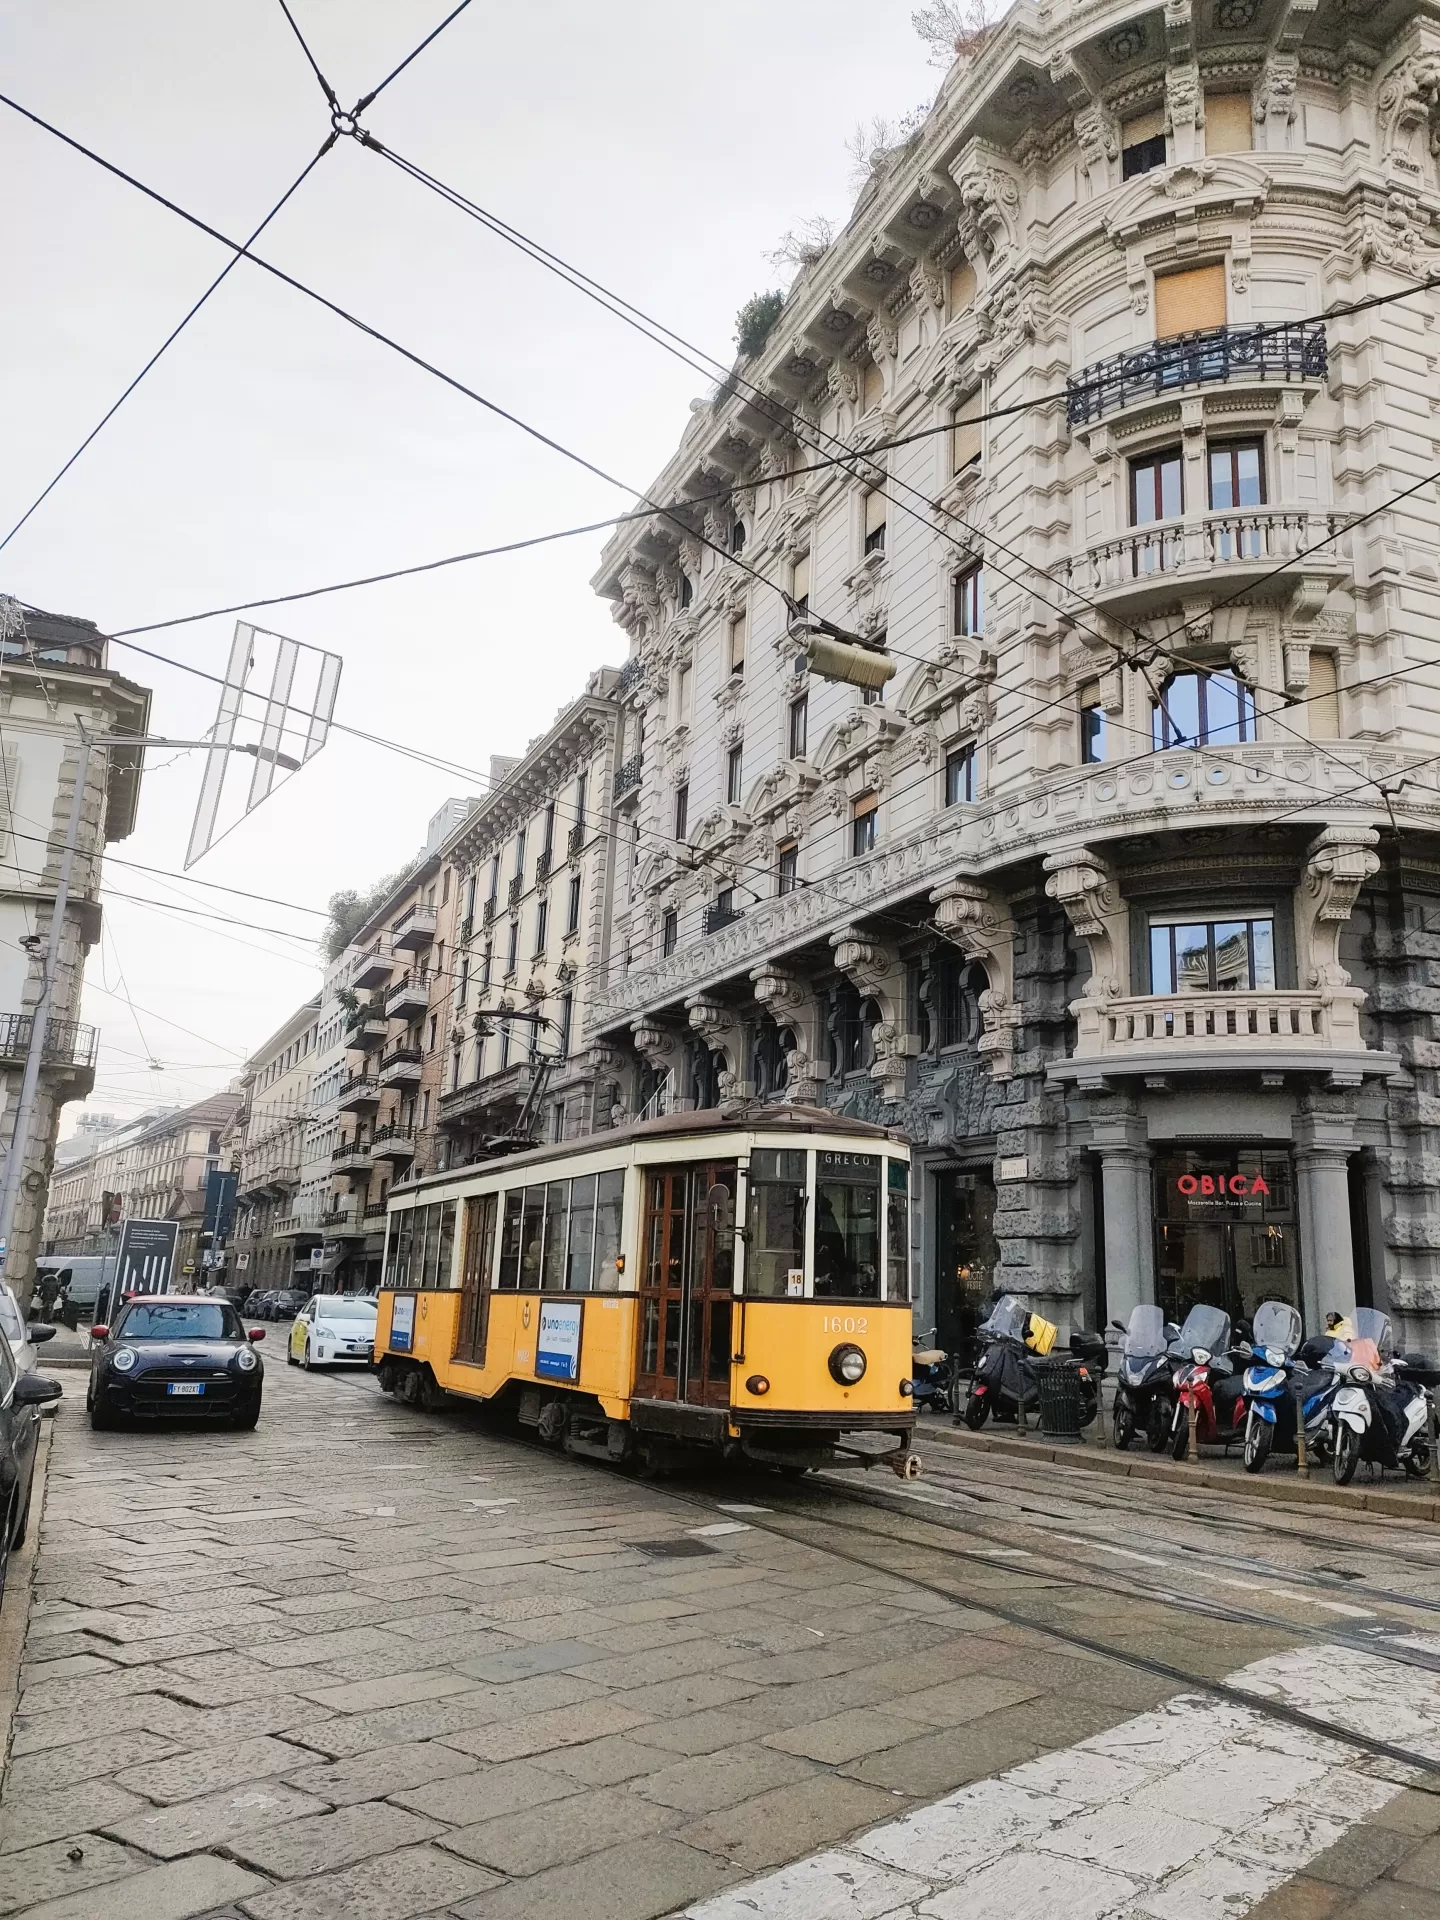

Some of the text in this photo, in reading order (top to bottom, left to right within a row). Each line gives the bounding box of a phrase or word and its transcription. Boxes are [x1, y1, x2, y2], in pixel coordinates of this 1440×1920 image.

[825, 1152, 870, 1166] GRECO
[1177, 1168, 1270, 1195] OBICÀ
[791, 1274, 802, 1284] 18
[793, 1285, 798, 1295] 1
[823, 1316, 869, 1334] 1602
